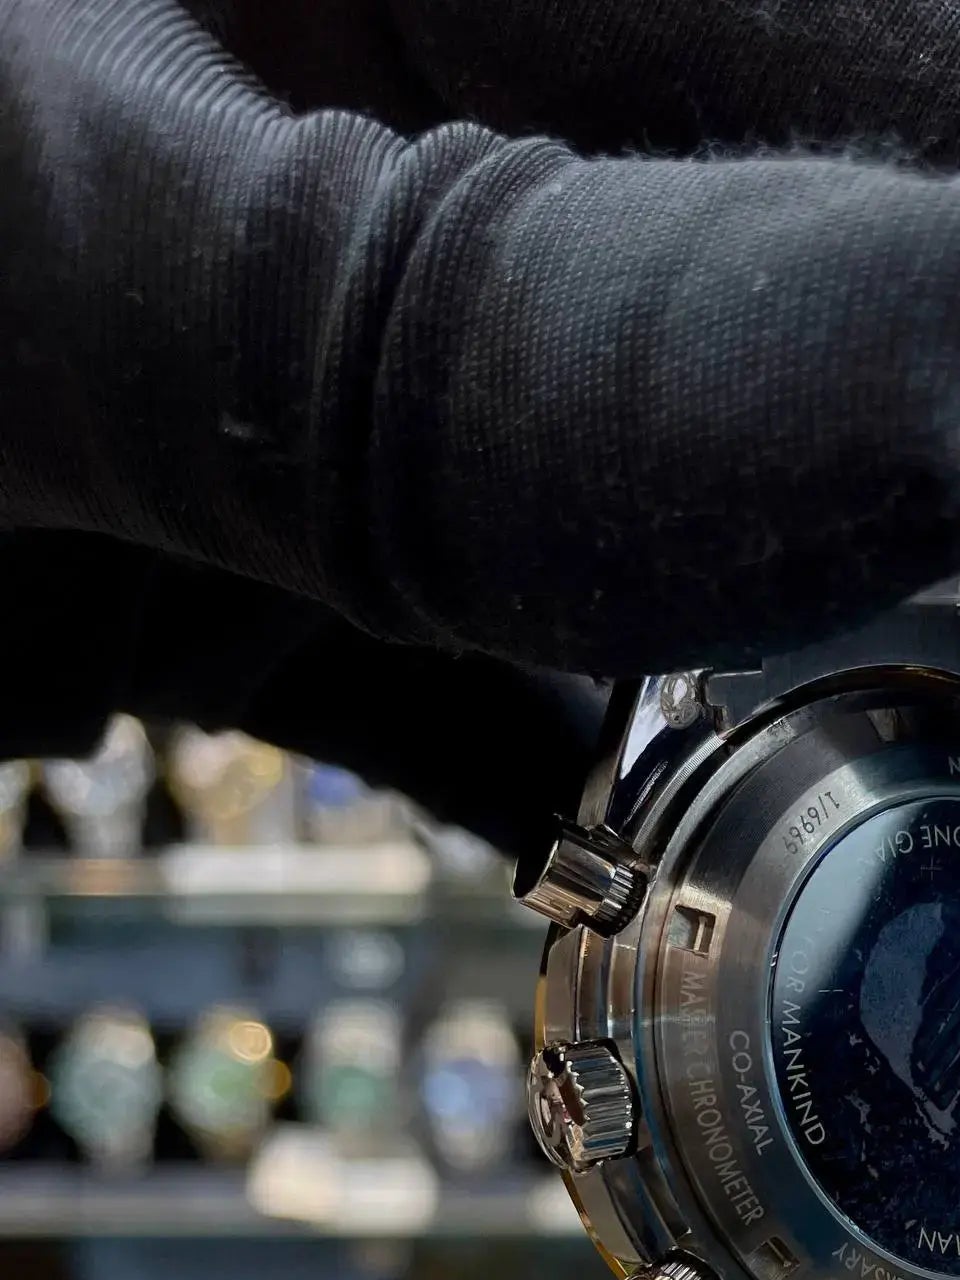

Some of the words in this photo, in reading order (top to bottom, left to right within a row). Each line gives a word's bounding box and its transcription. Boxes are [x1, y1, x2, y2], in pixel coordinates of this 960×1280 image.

[782, 791, 840, 855] 1/6969
[875, 829, 914, 863] GIA
[729, 1030, 774, 1156] CO-AXIAL
[780, 1000, 826, 1145] MANKIND
[686, 1062, 765, 1226] CHRONOMETER
